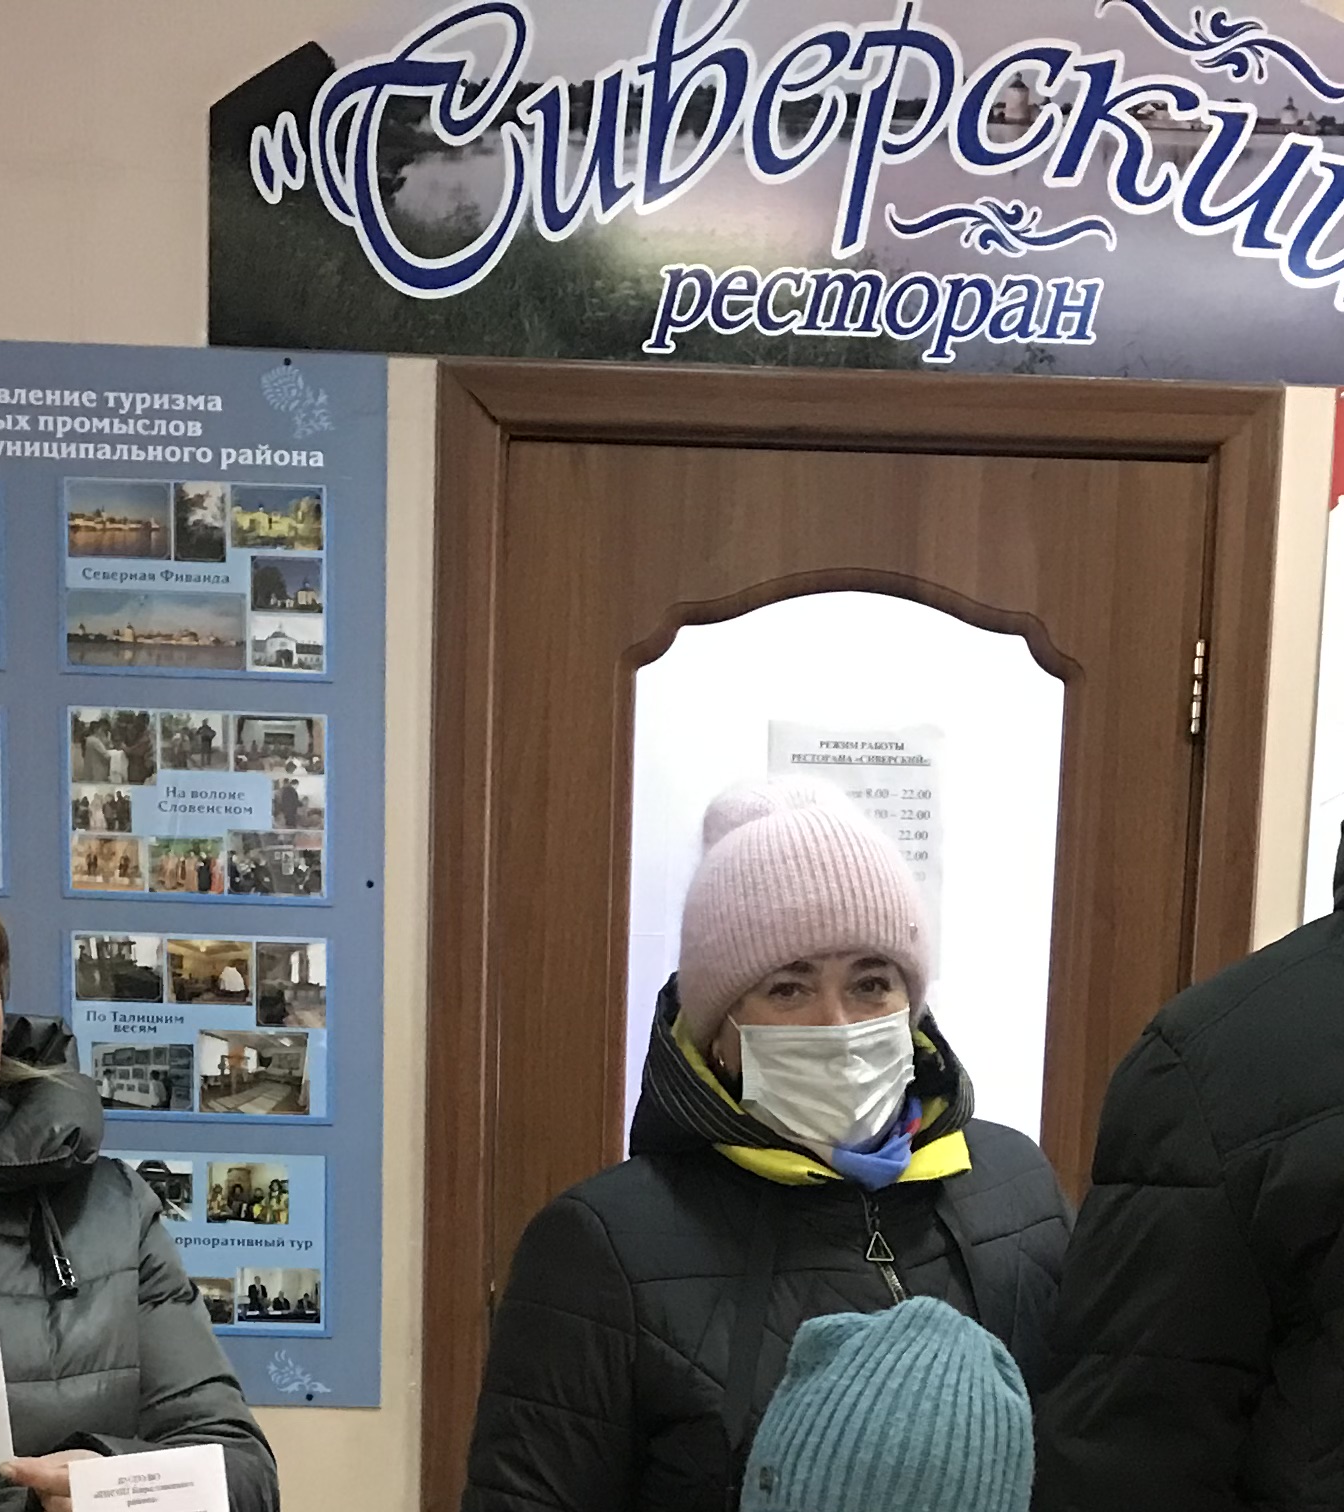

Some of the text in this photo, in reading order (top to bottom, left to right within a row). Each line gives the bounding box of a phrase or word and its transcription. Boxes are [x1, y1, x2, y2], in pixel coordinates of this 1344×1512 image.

[643, 263, 1104, 363] ресторан
[103, 391, 222, 414] туризма
[38, 414, 203, 437] промыслов
[221, 443, 324, 470] района
[82, 567, 155, 583] Северная
[860, 741, 905, 751] РАБОТЫ
[166, 786, 246, 801] На волоке
[901, 788, 932, 800] 22.00
[158, 801, 253, 815] Словенском
[900, 809, 931, 821] 22.00
[898, 829, 929, 841] 22.00
[86, 1010, 185, 1025] По Талицким
[113, 1024, 157, 1034] весям
[175, 1237, 313, 1250] орпоративный тур
